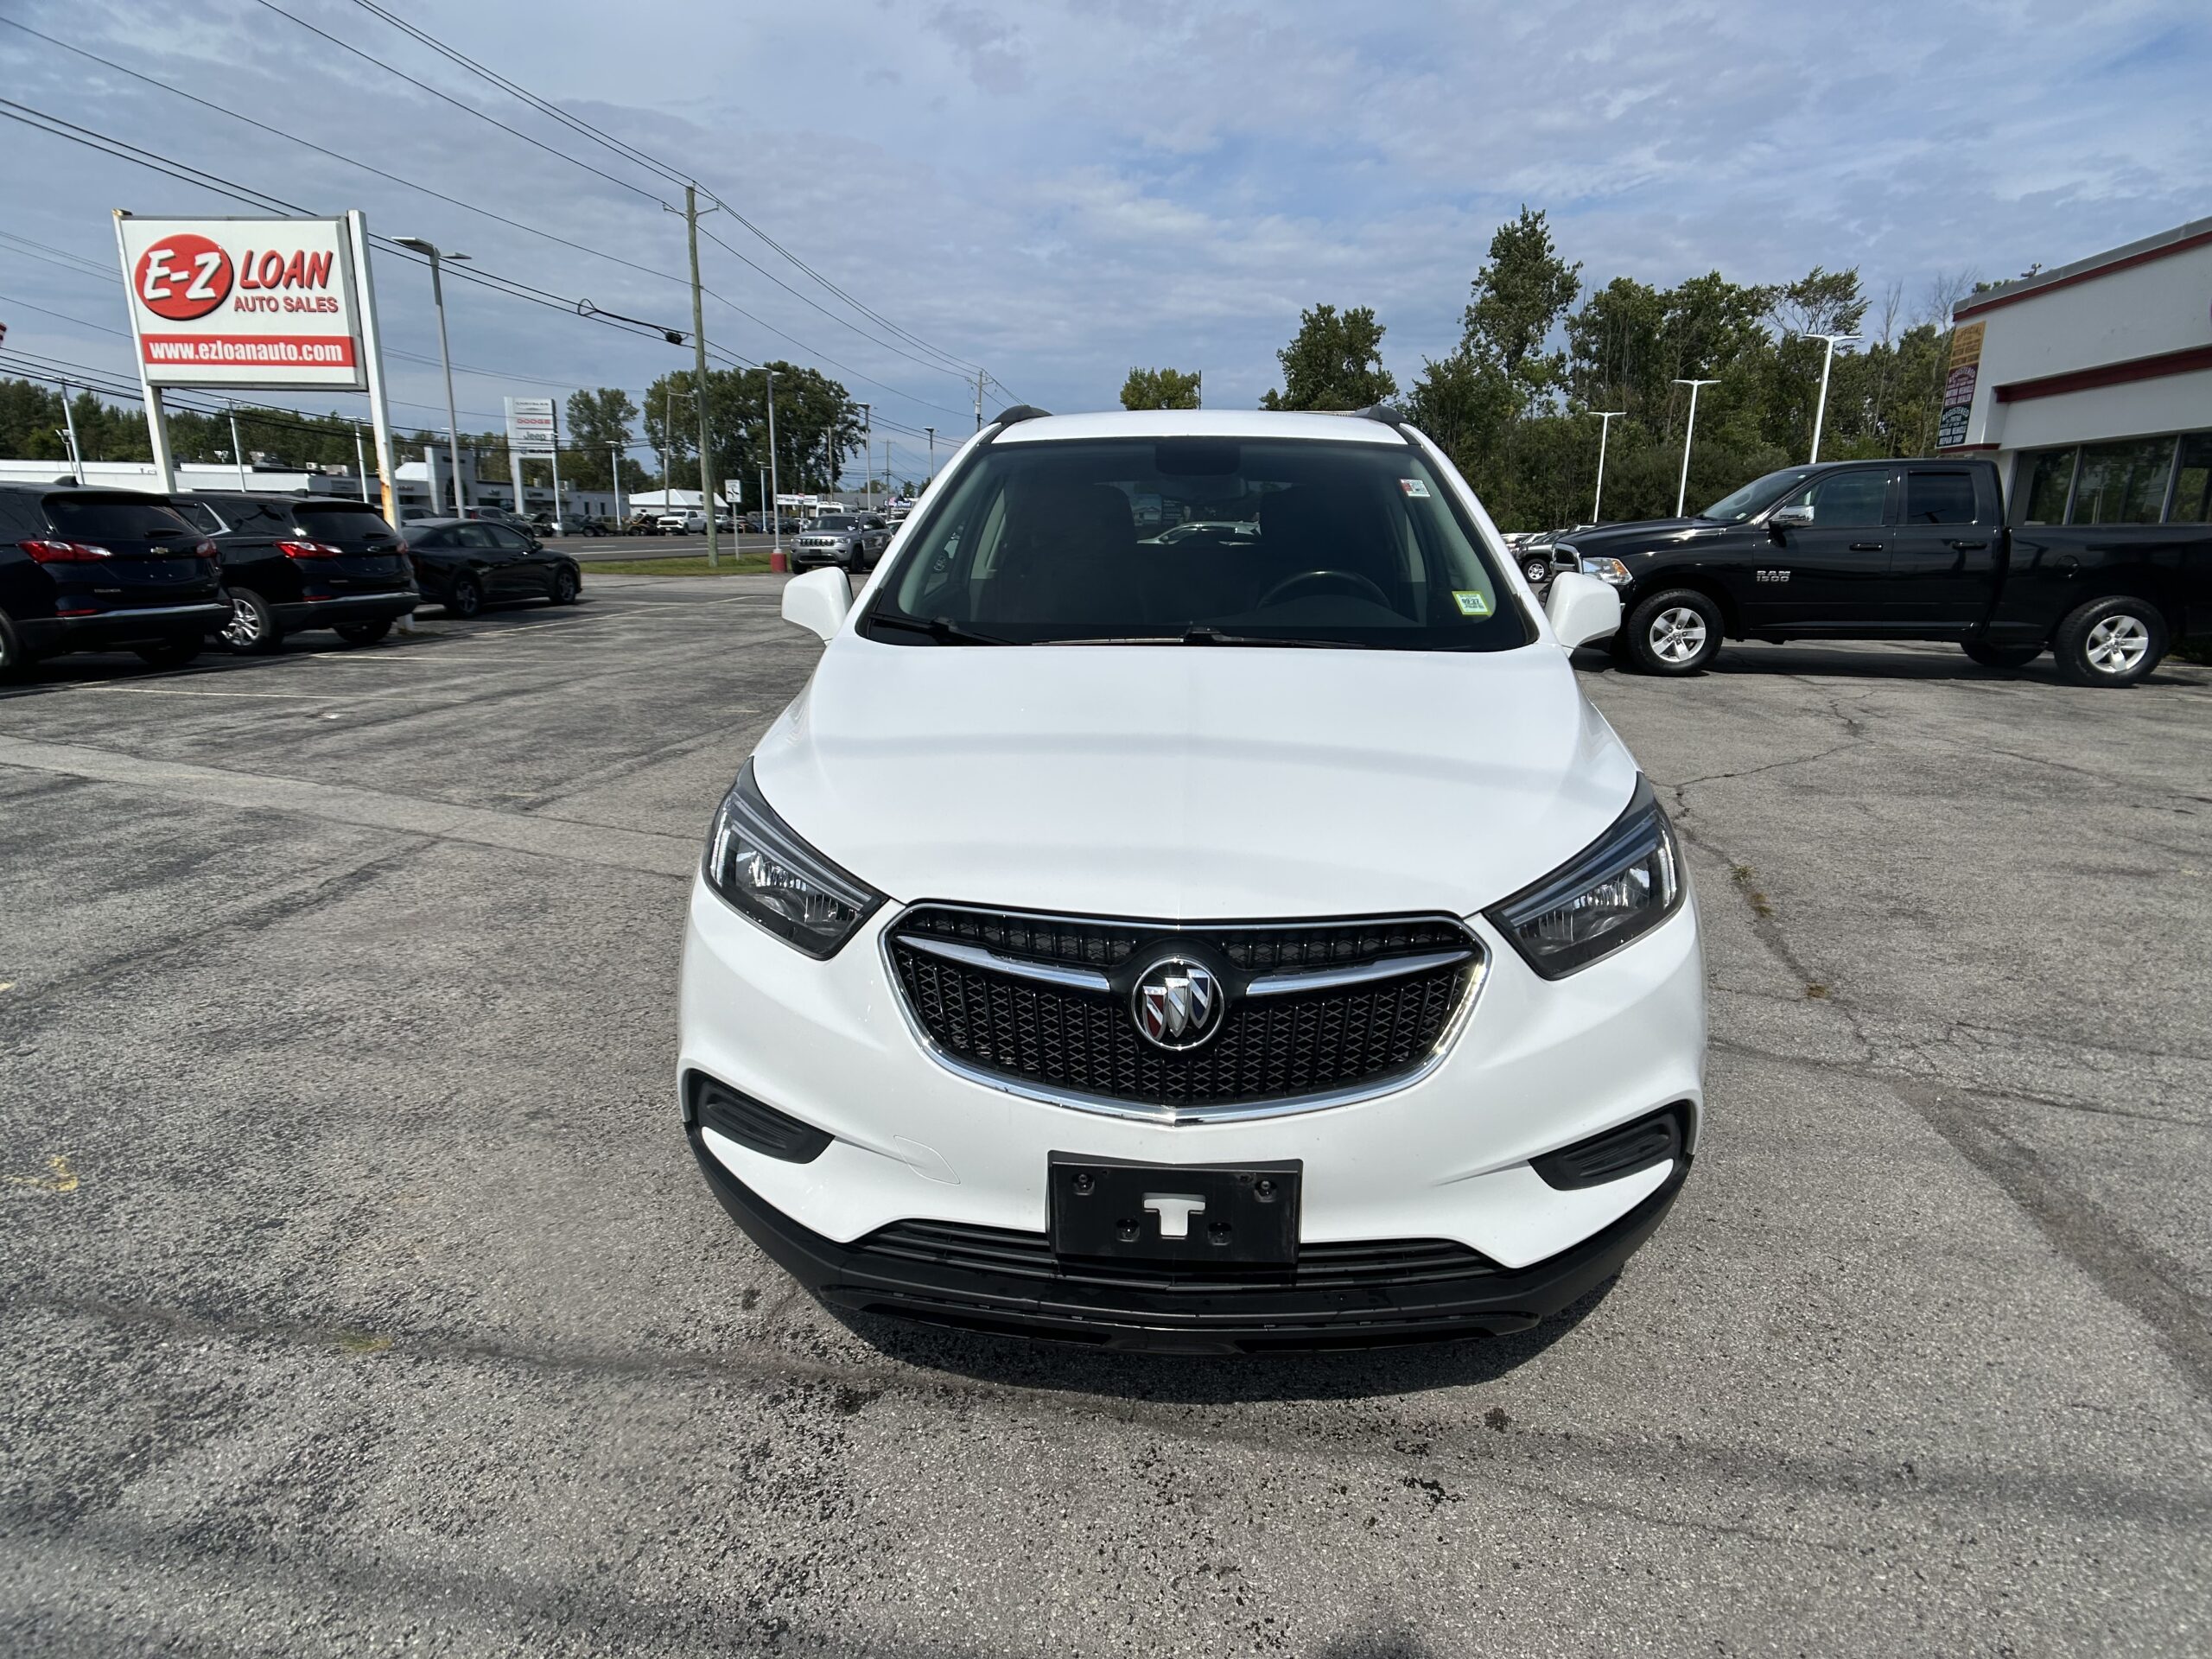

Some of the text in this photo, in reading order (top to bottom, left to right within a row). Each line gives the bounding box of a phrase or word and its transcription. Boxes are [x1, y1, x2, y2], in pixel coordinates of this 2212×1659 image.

[143, 248, 334, 301] E-Z LOAN
[234, 296, 339, 313] AUTO SALES
[148, 340, 343, 362] www.ezloanauto.com
[524, 432, 546, 442] Jeep
